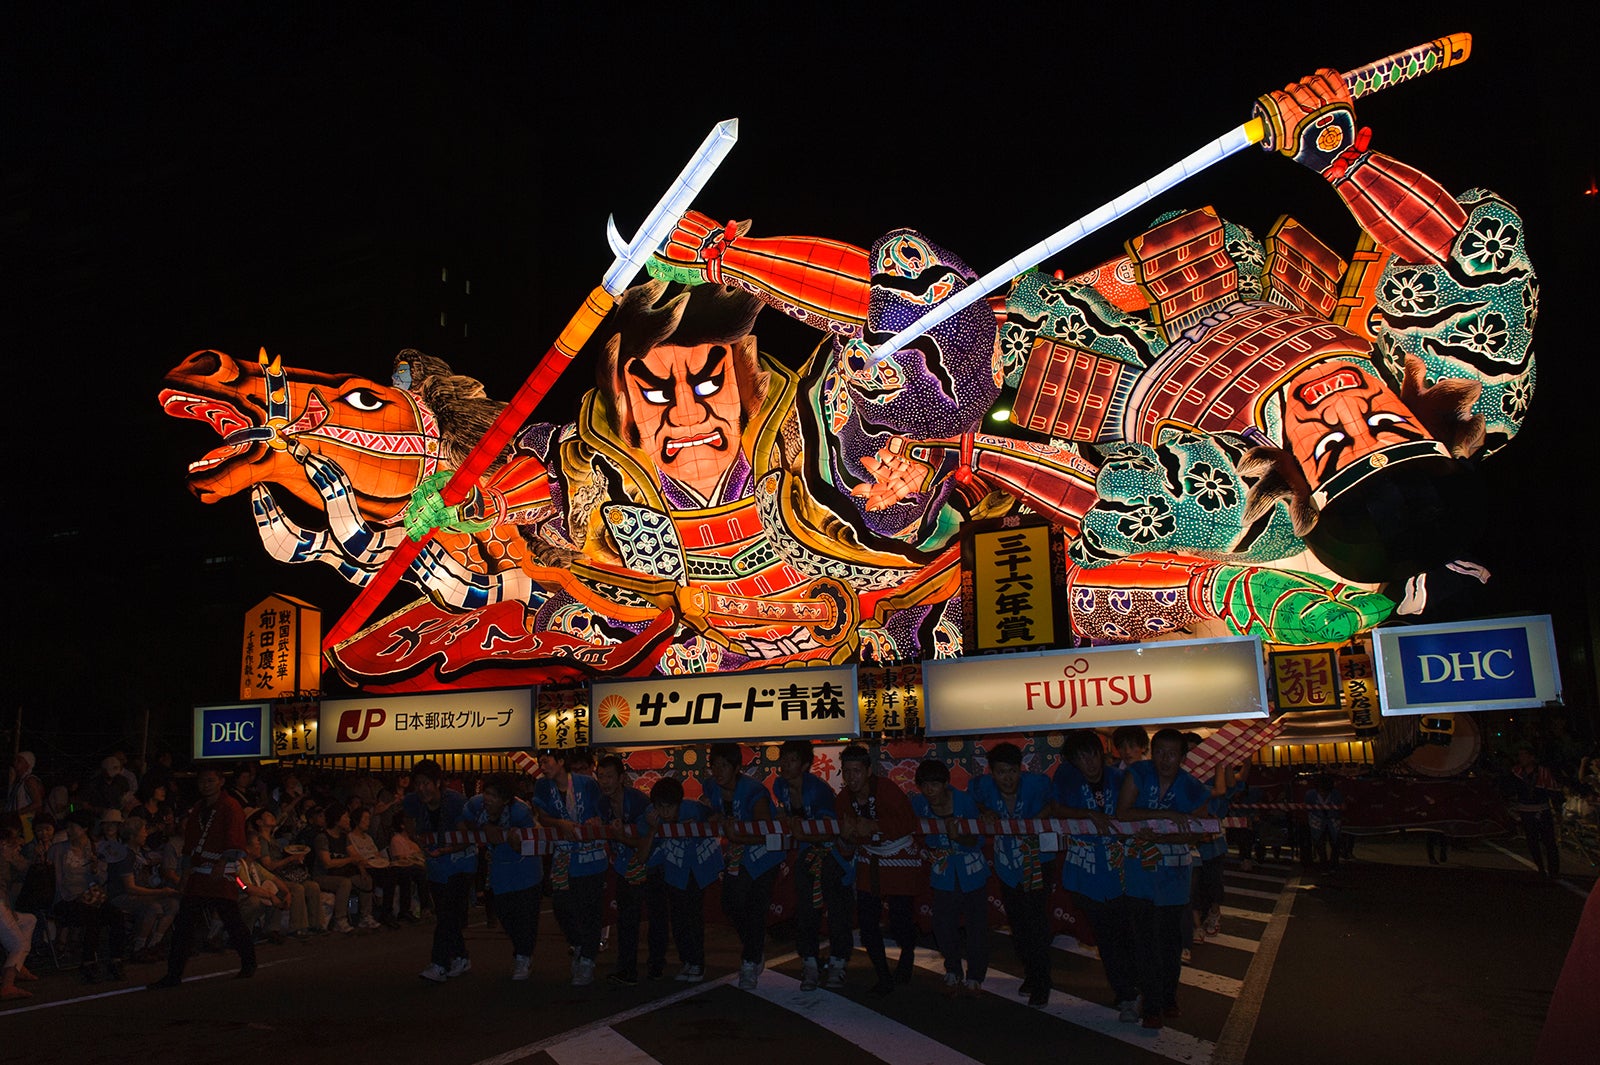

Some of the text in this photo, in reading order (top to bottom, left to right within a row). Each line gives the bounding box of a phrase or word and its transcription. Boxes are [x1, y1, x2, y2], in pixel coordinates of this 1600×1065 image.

[994, 533, 1035, 644] 三十六年賞
[256, 608, 277, 690] 前田慶次
[1417, 649, 1516, 684] DHC
[881, 668, 901, 727] 東洋社
[1025, 673, 1153, 719] FUJITSU
[1279, 657, 1332, 704] 龍
[336, 708, 387, 743] JP
[394, 707, 514, 732] 日本郵政グループ
[636, 681, 845, 728] サンロード青森
[210, 720, 255, 743] DHC
